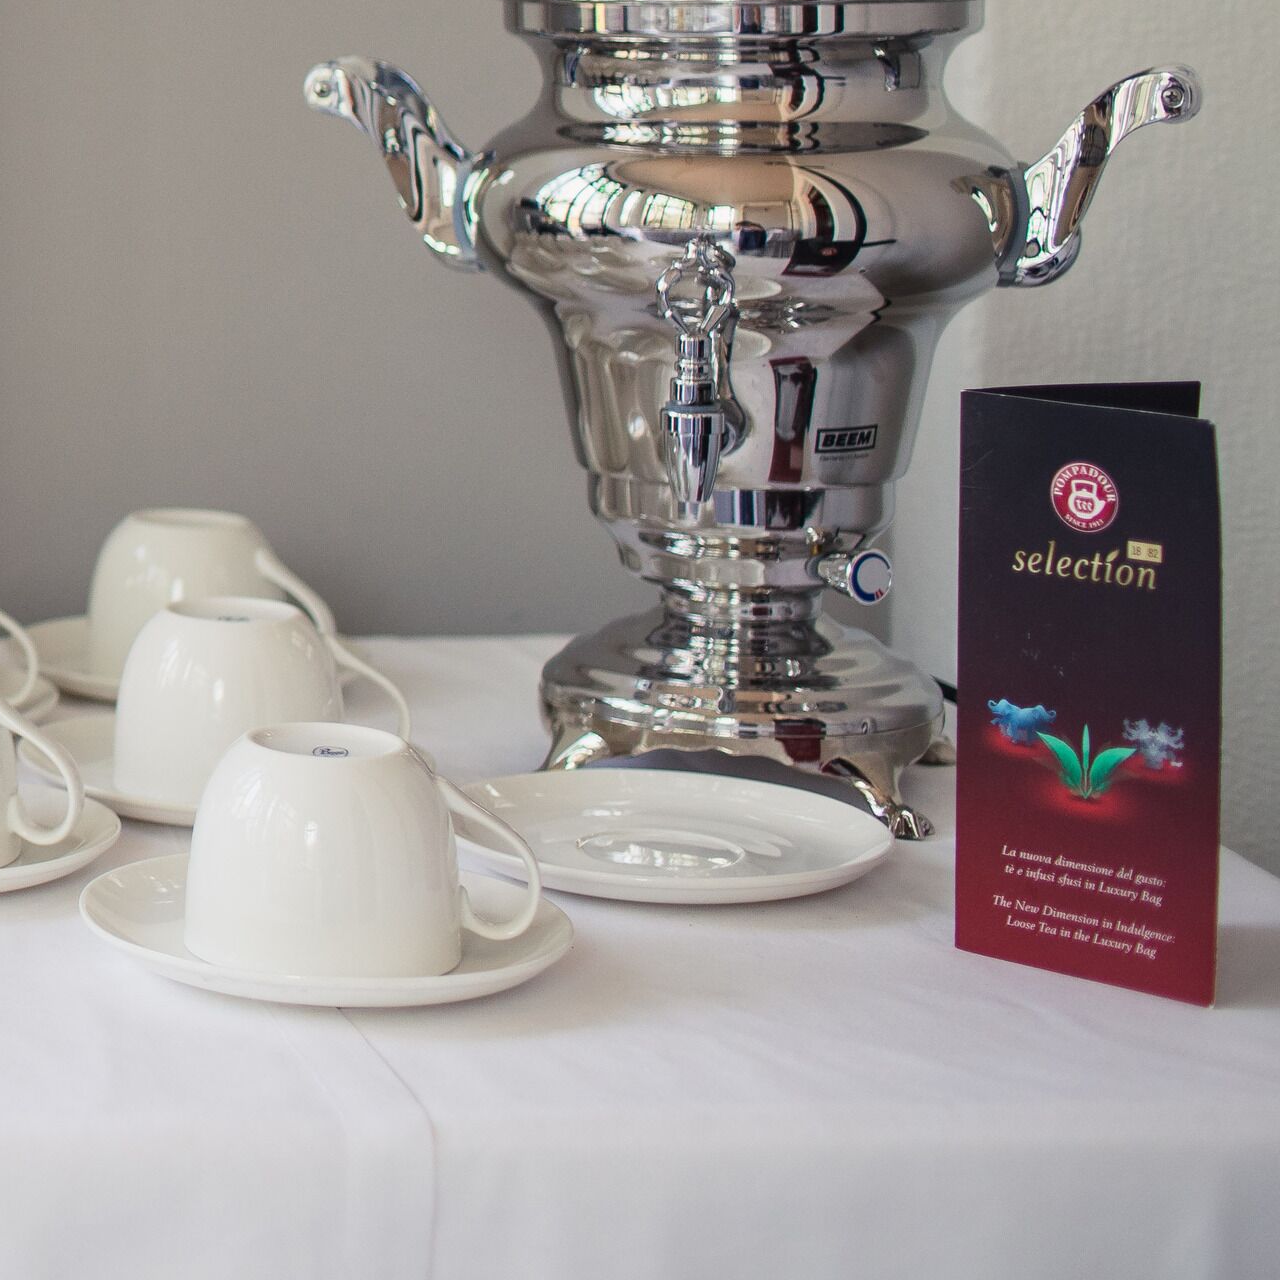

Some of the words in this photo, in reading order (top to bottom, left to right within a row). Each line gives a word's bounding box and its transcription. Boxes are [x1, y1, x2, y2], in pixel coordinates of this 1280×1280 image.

[822, 430, 872, 447] BEEM
[1053, 466, 1116, 502] POMPADOUR
[1064, 513, 1087, 528] SINCE
[1012, 540, 1156, 590] selection
[1002, 844, 1017, 857] La
[1019, 850, 1052, 864] nuova
[1055, 855, 1114, 877] dimensione
[1116, 867, 1133, 881] del
[1135, 872, 1167, 888] gusto:
[1005, 864, 1015, 874] tè
[1025, 867, 1056, 882] infusi
[1058, 873, 1082, 888] sfusi
[1085, 879, 1096, 891] in
[1098, 881, 1138, 902] Luxury
[1141, 890, 1163, 907] Bag
[993, 894, 1012, 909] The
[1014, 899, 1040, 913] New
[1043, 905, 1099, 926] Dimension
[1102, 918, 1113, 930] in
[1116, 920, 1176, 943] Indulgence:
[1006, 915, 1036, 930] Loose
[1039, 921, 1057, 935] Tea
[1060, 927, 1071, 938] in
[1074, 929, 1090, 942] the
[1093, 933, 1132, 954] Luxury
[1136, 942, 1157, 960] Bag
